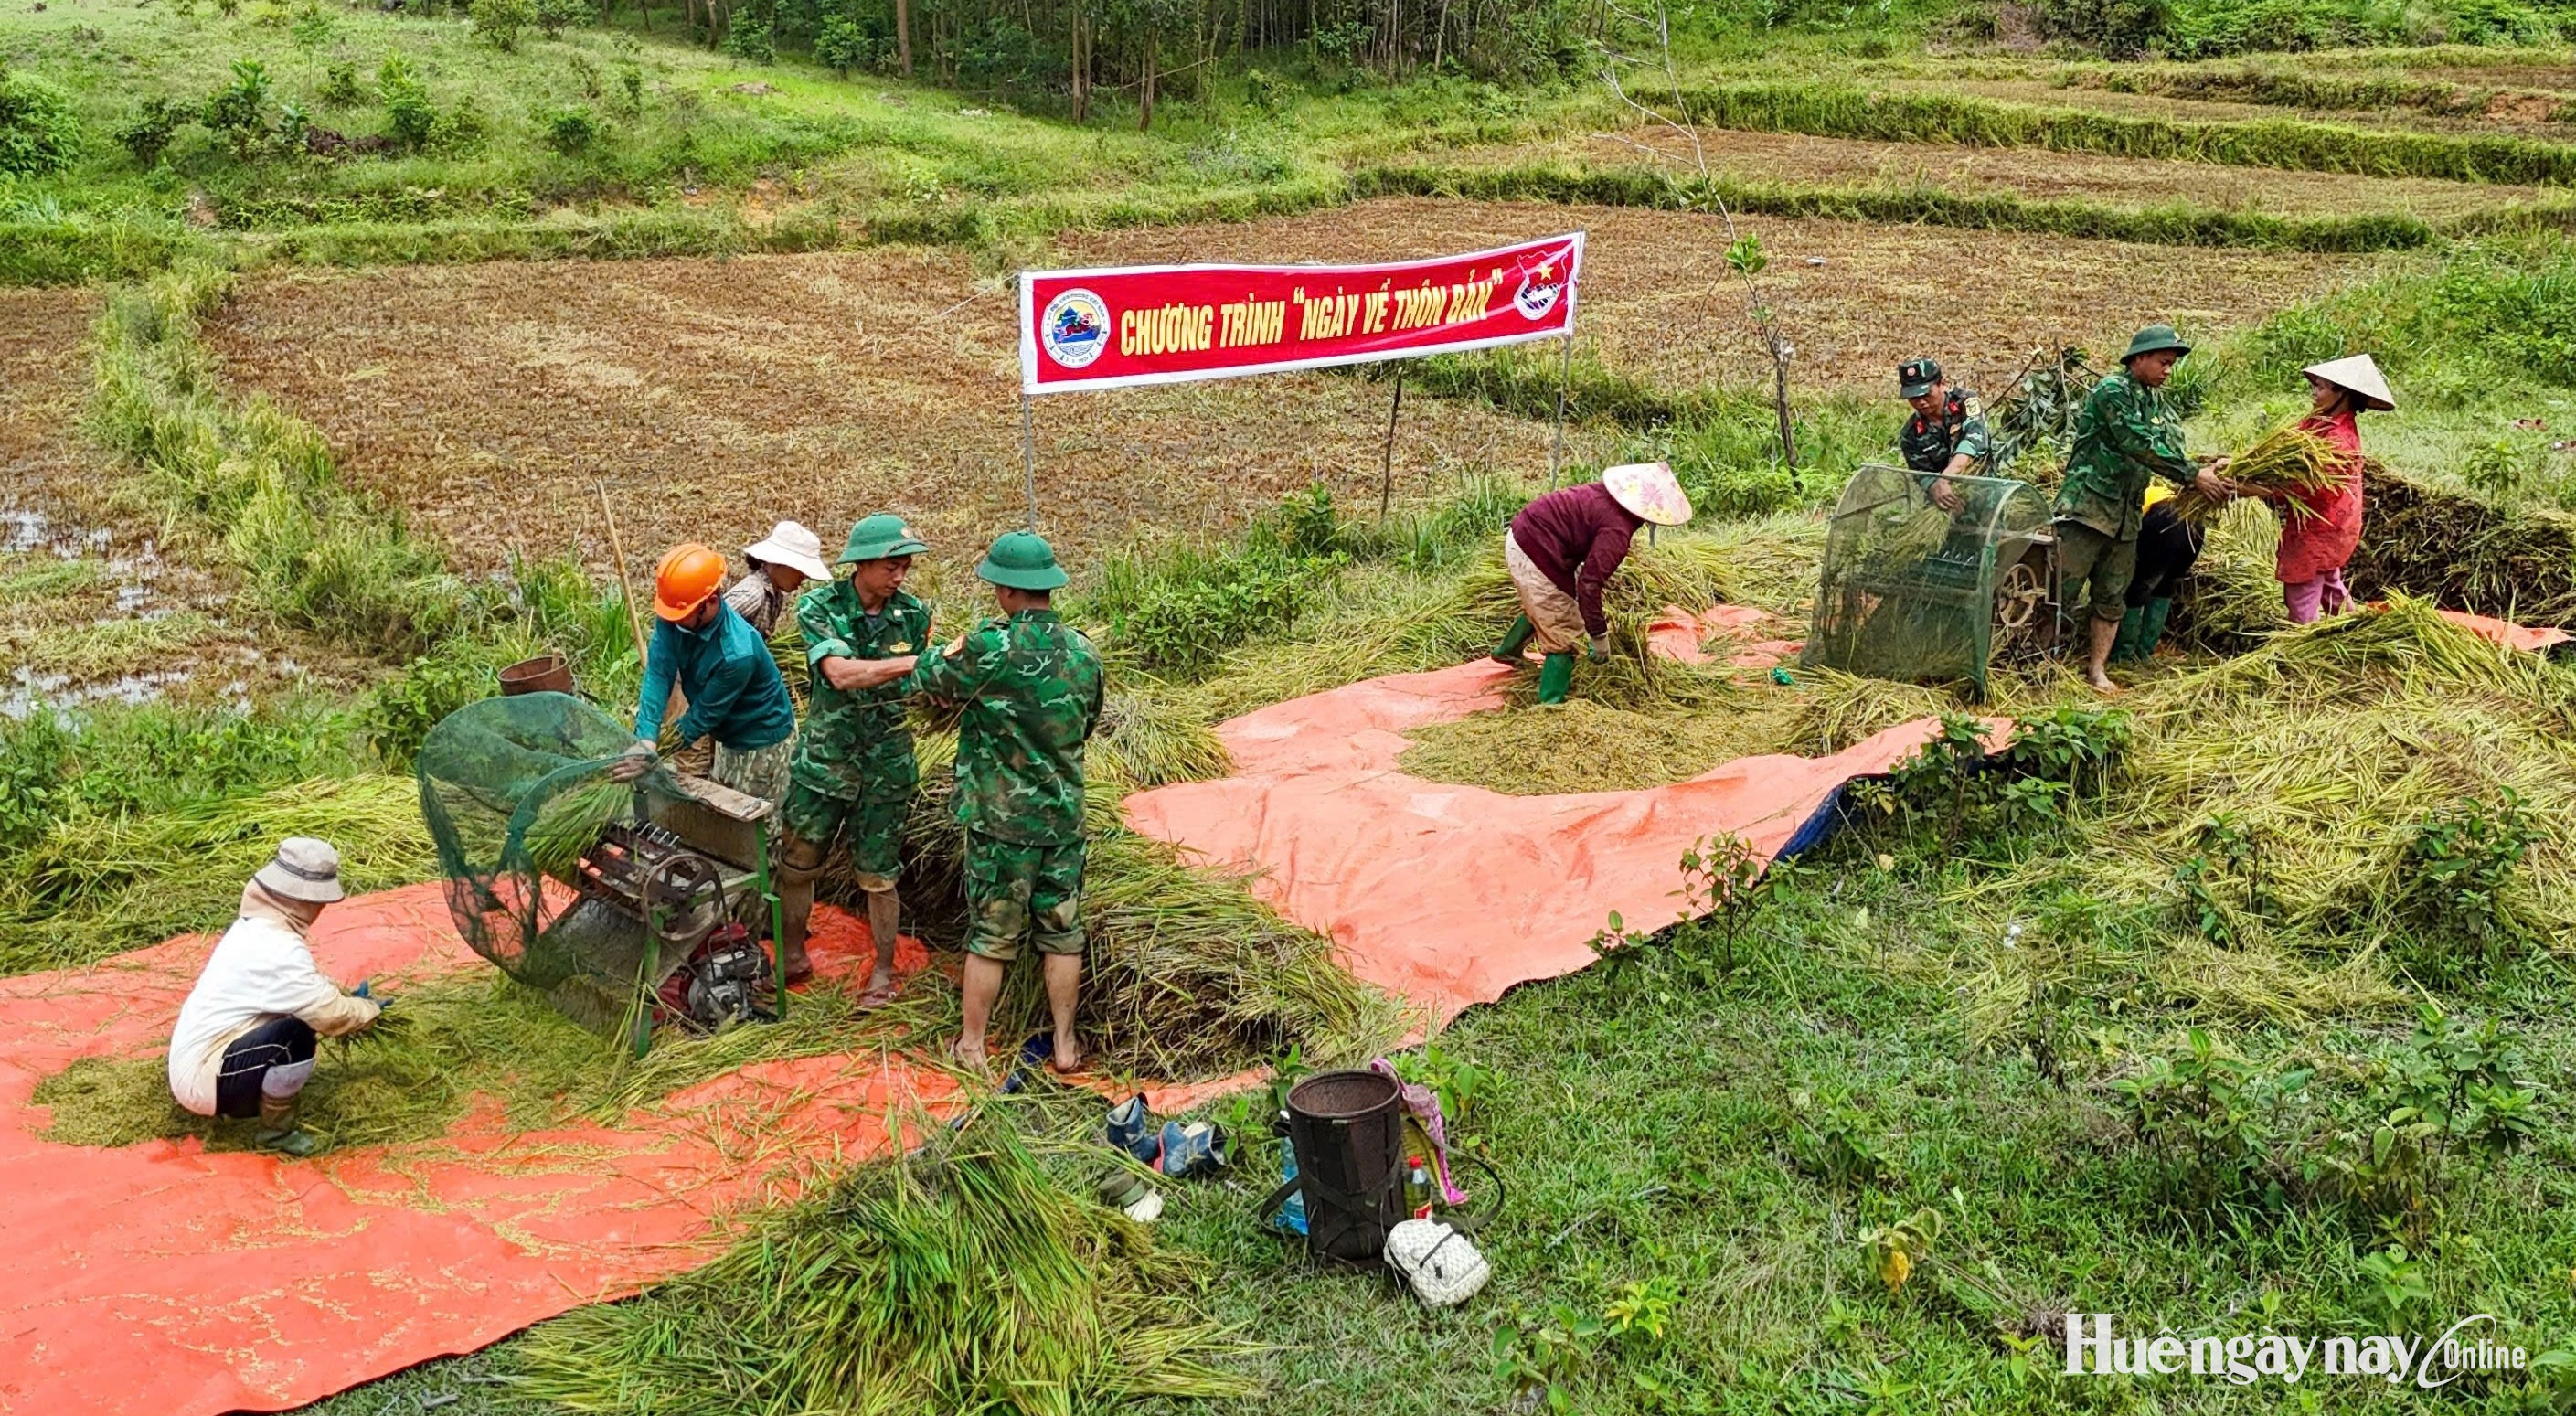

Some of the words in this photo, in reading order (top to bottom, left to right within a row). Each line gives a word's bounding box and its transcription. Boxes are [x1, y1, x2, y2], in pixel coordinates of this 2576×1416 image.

[1121, 303, 1214, 357] CHƯƠNG
[1219, 293, 1286, 348] TRÌNH
[1392, 278, 1447, 330] THÔN
